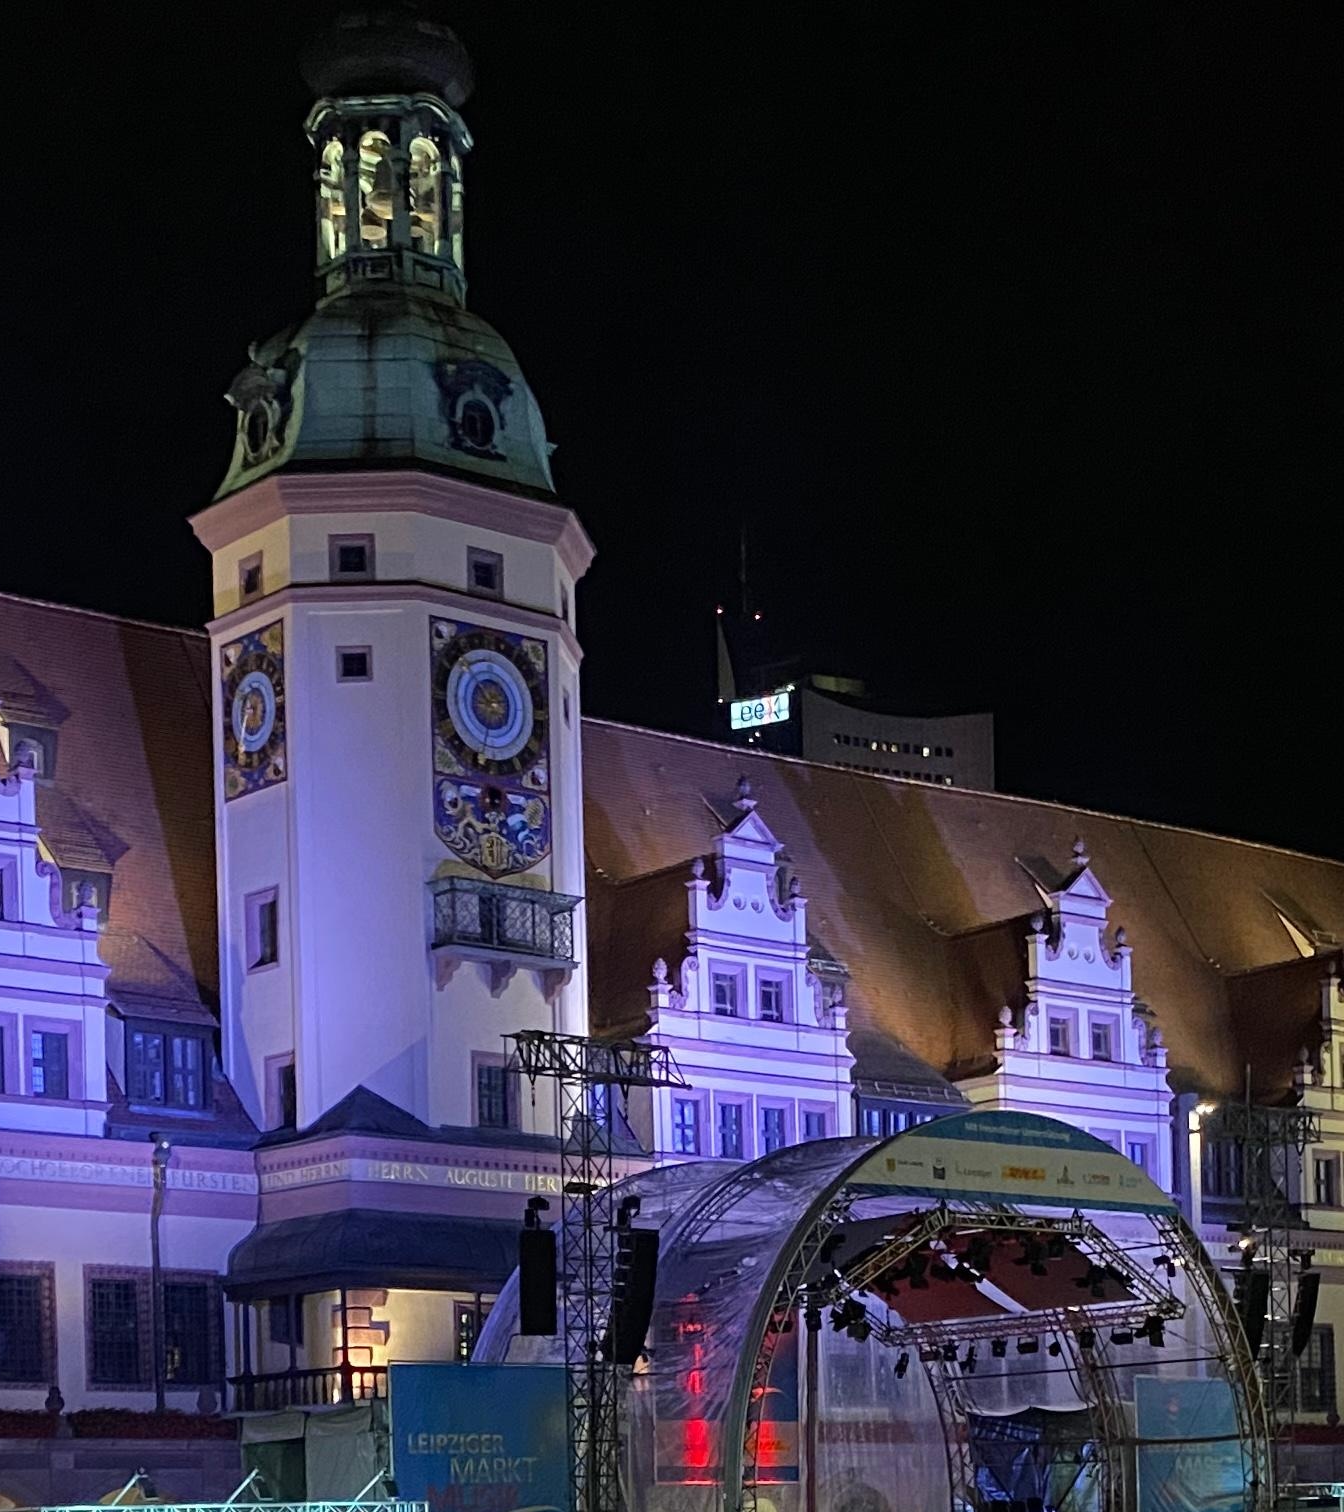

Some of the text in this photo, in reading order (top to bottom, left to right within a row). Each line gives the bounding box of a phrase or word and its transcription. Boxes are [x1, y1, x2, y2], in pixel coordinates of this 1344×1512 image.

[300, 1163, 344, 1182] HERRN
[367, 1160, 429, 1182] HERRN
[445, 1167, 513, 1190] AUGUSTI
[407, 1433, 506, 1455] LEIPZIGER
[450, 1456, 538, 1483] MARKT
